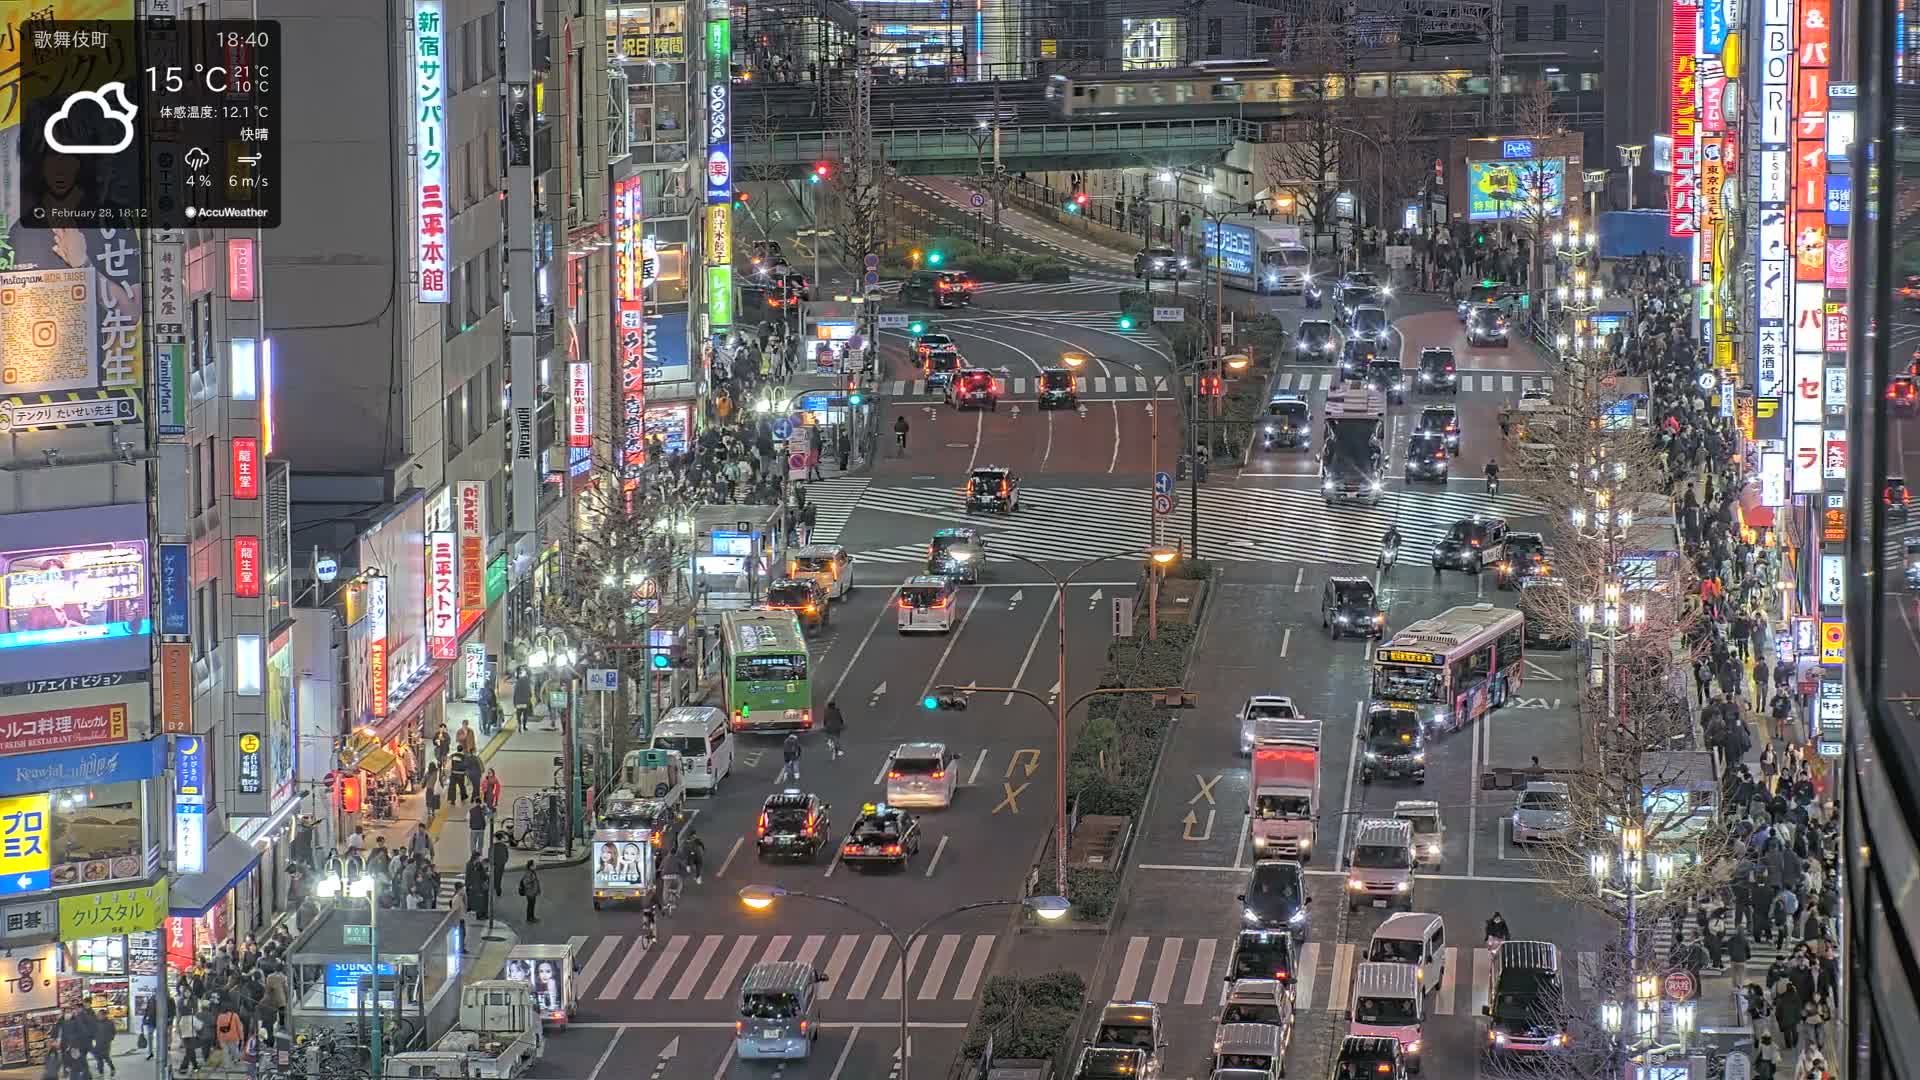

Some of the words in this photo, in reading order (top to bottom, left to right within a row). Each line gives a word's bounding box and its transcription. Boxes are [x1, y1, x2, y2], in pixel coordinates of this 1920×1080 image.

[418, 11, 441, 170] 新宿サンパーク
[421, 184, 444, 292] 三平本館
[1762, 330, 1775, 382] 大衆酒場
[160, 353, 173, 415] FamilyMart
[1797, 307, 1821, 469] パセラ
[518, 407, 530, 460] HOMEGAME
[435, 541, 453, 629] 三平ストア
[27, 673, 122, 693] リアエイドビジョン
[7, 910, 42, 932] 囲碁
[72, 902, 145, 927] クリスタル
[335, 962, 387, 972] SUBNAE
